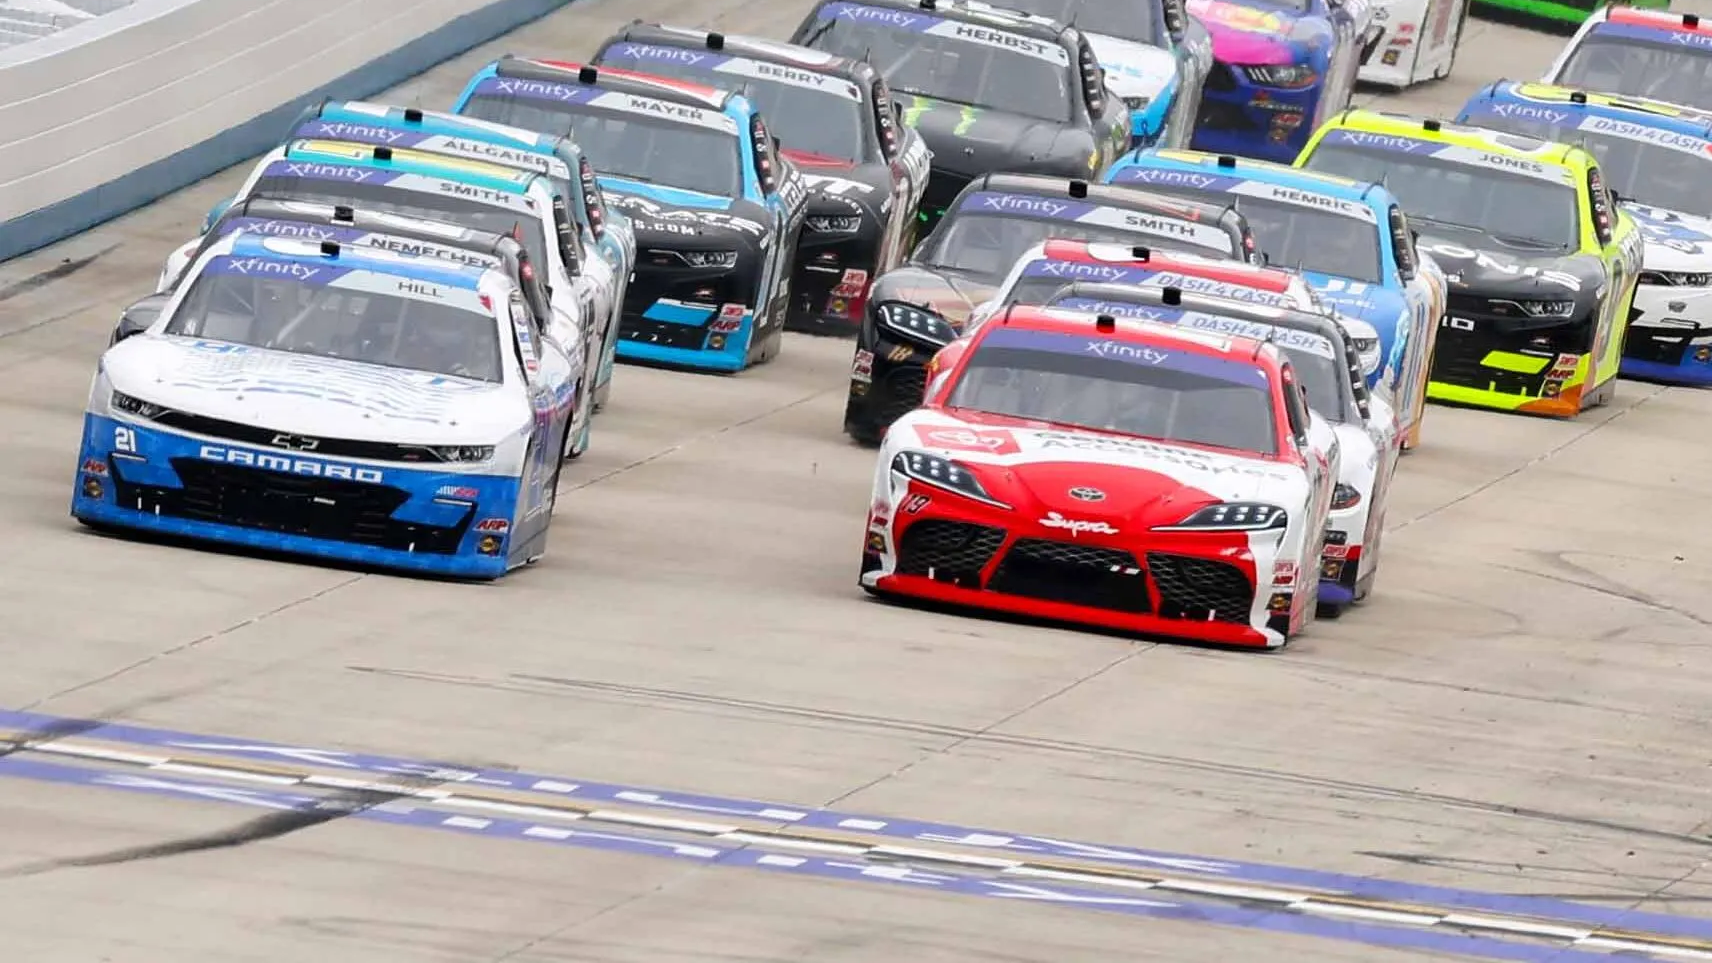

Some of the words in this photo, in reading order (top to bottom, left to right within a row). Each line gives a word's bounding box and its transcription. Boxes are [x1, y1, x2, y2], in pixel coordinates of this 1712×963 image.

[839, 4, 919, 28] xfinity
[955, 24, 1049, 56] HERBST
[623, 42, 706, 65] xfinity
[757, 64, 828, 87] BERRY
[495, 78, 581, 100] xfinity
[629, 98, 705, 122] MAYER
[1491, 100, 1570, 125] xfinity
[319, 121, 406, 143] xfinity
[1342, 129, 1421, 152] xfinity
[444, 138, 549, 168] ALLGAIER
[1478, 152, 1544, 175] JONES
[286, 161, 374, 183] xfinity
[1133, 168, 1217, 190] xfinity
[439, 182, 511, 204] SMITH
[982, 193, 1068, 217] xfinity
[1271, 187, 1354, 213] HEMRIC
[249, 220, 336, 241] xfinity
[1124, 214, 1196, 240] SMITH
[370, 237, 497, 268] NEMECHEK
[228, 257, 321, 281] xfinity
[1042, 261, 1128, 281] xfinity
[398, 281, 444, 299] HILL
[1157, 273, 1214, 294] DASH
[1229, 283, 1284, 308] CASH
[1192, 316, 1249, 336] DASH
[1087, 340, 1170, 365] xfinity
[114, 426, 137, 453] 21
[200, 445, 385, 484] CAMARO
[1039, 511, 1120, 537] Supra
